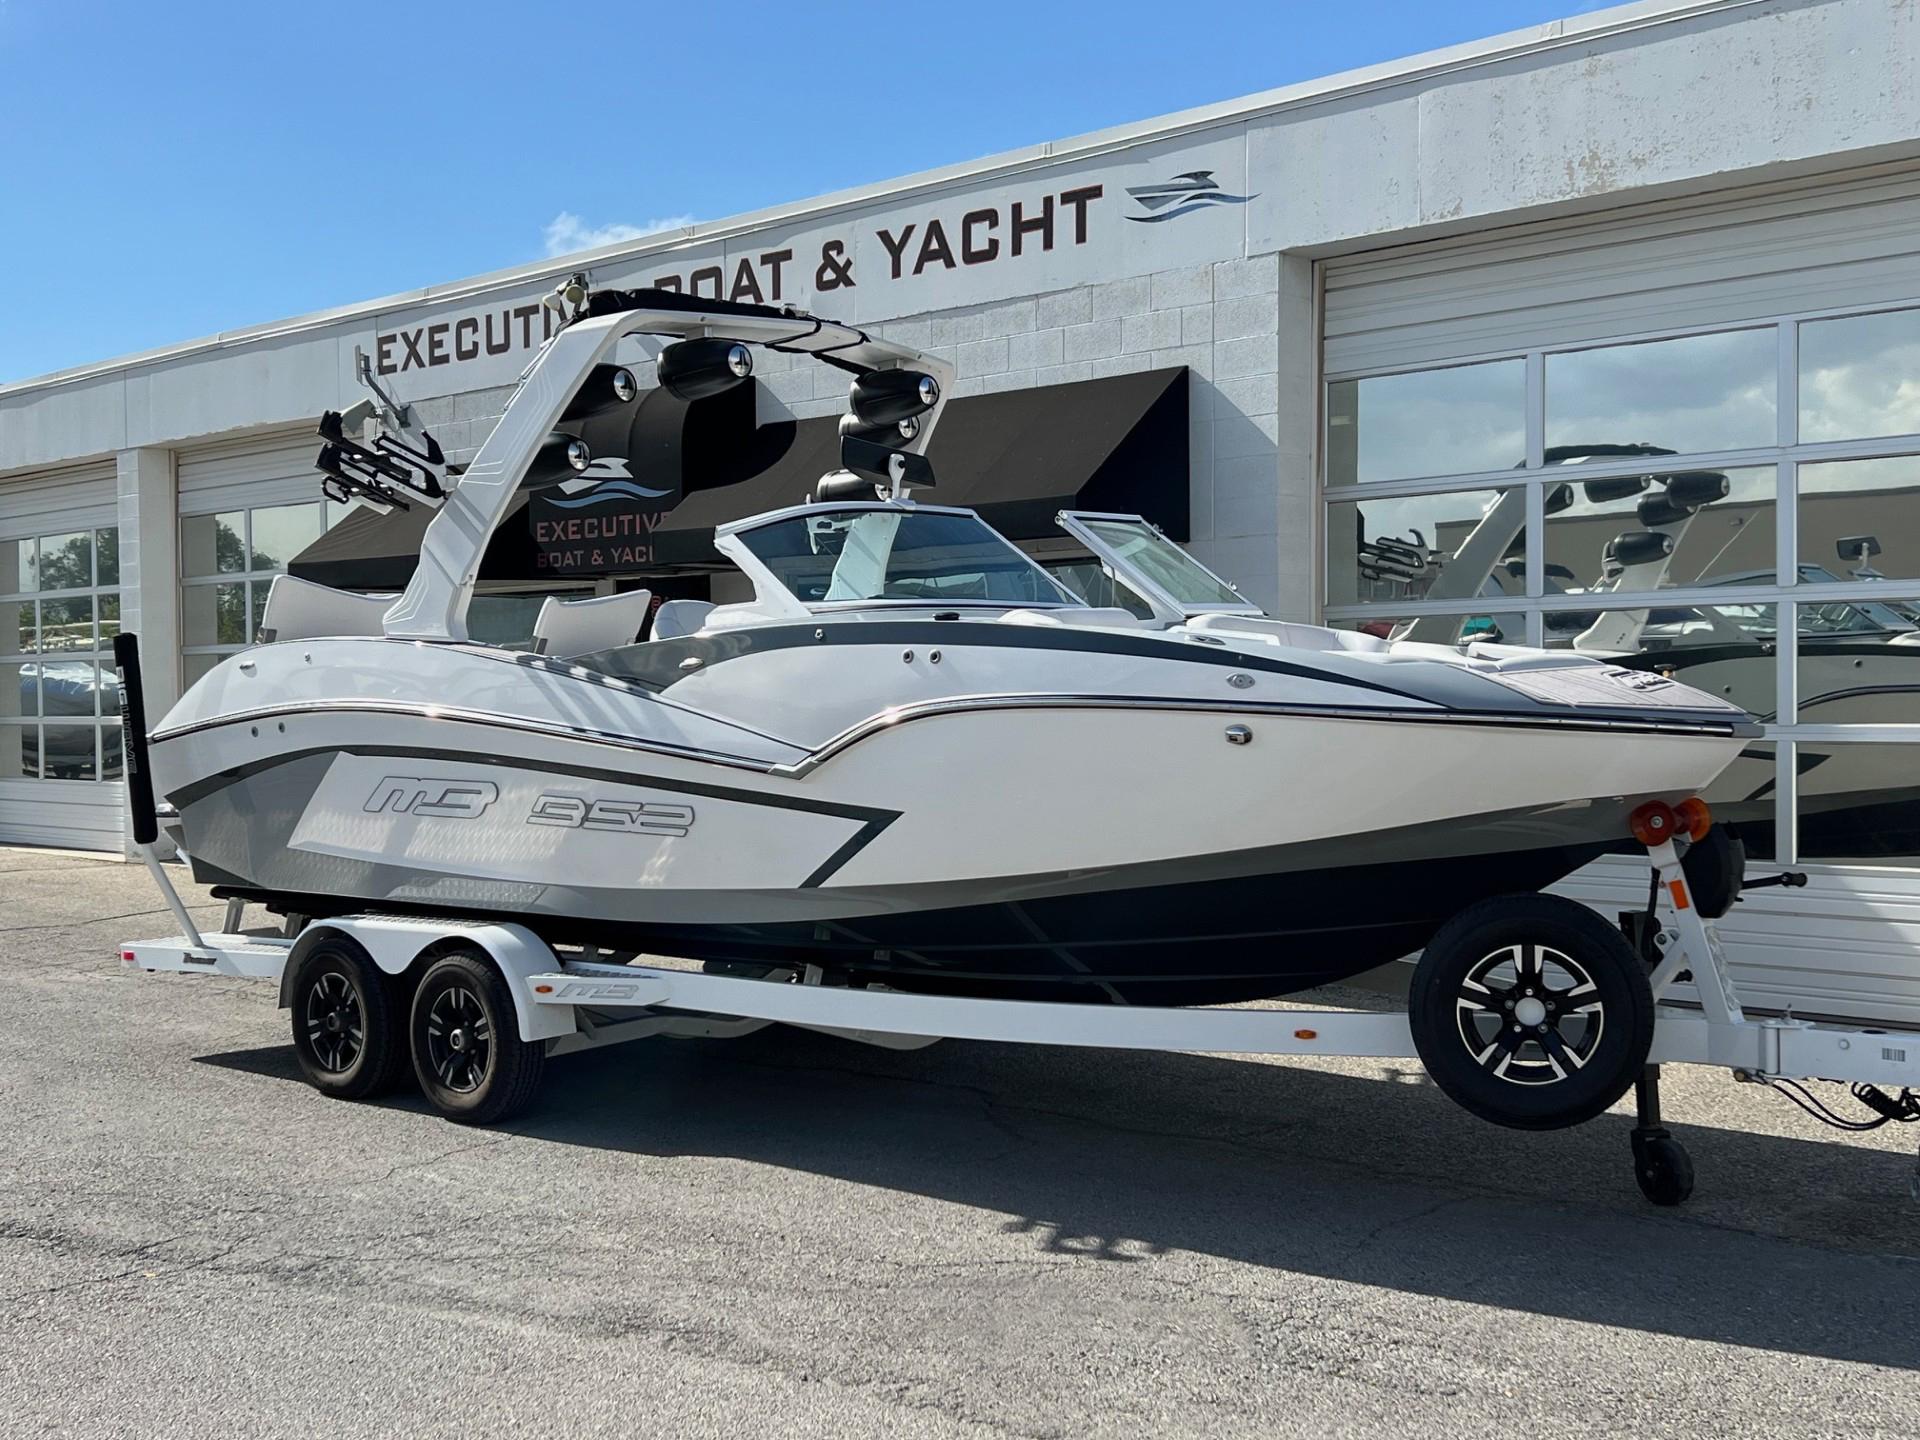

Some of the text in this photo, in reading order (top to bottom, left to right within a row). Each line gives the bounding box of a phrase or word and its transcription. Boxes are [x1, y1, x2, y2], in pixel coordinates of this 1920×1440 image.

[377, 300, 583, 376] EXECUTI
[815, 239, 856, 292] &
[876, 184, 1103, 280] YACHT
[537, 545, 653, 569] BOAT & YAC
